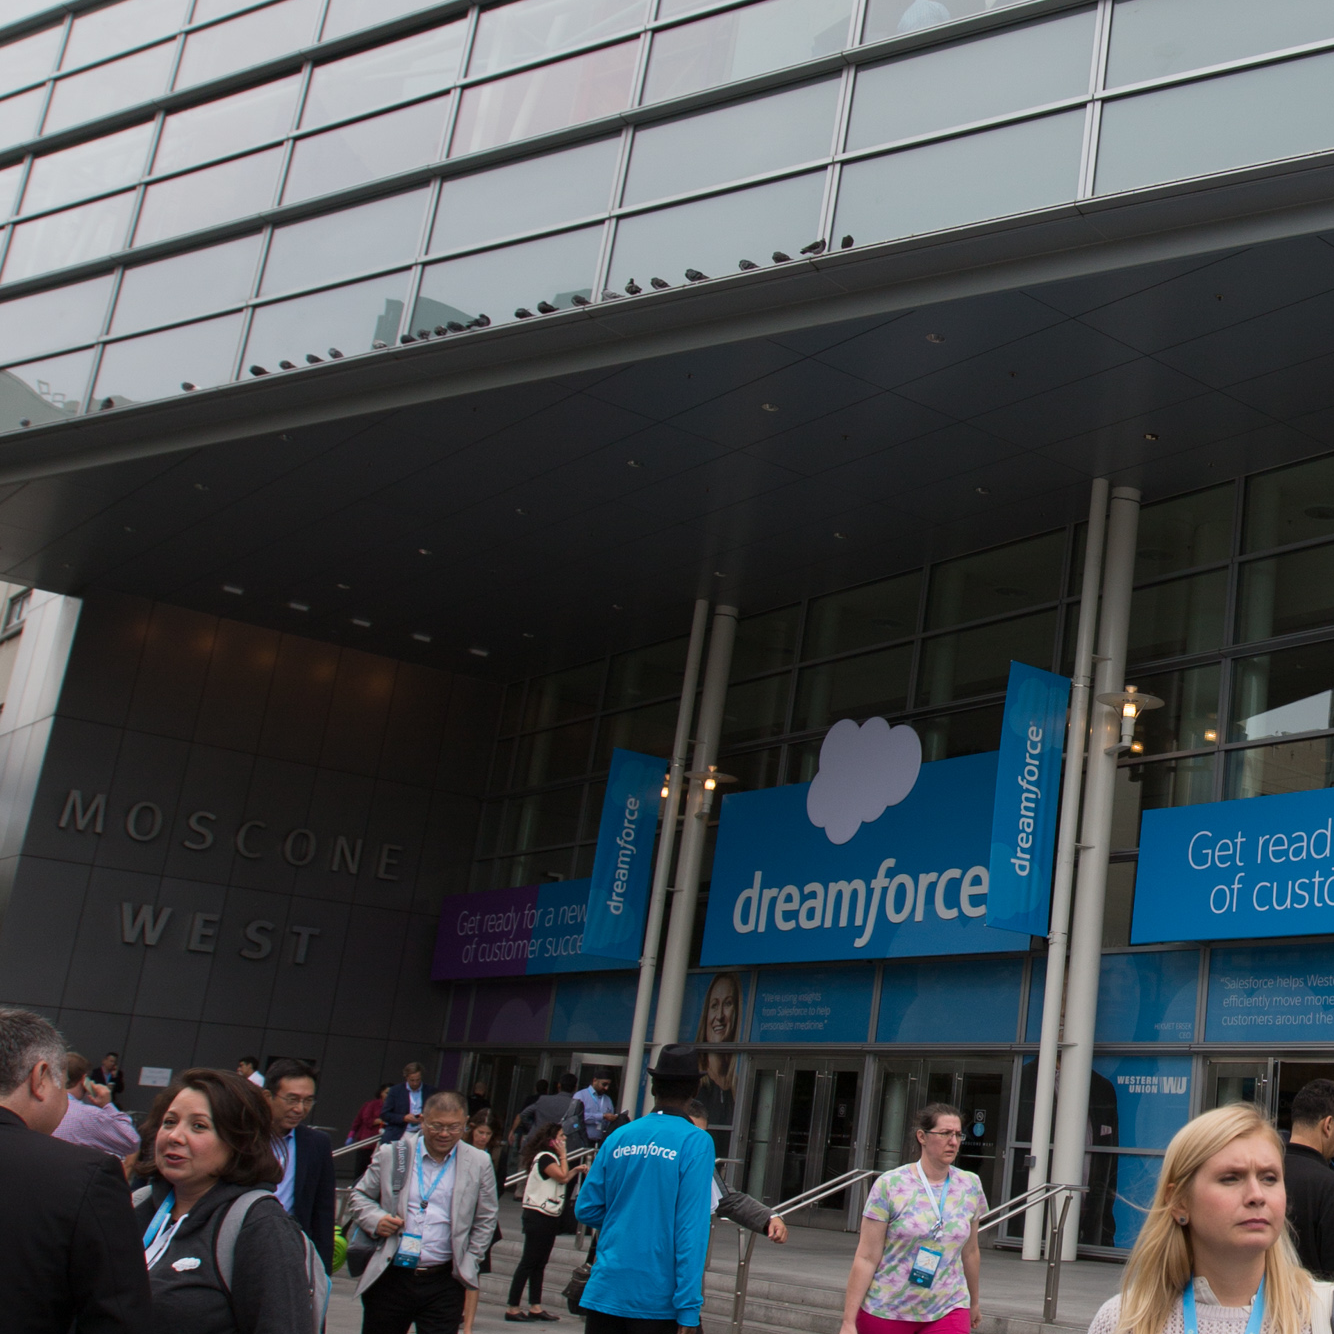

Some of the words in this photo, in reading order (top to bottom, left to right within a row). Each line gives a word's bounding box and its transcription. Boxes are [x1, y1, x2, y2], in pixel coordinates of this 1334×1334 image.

[1010, 725, 1042, 877] dreamforce
[57, 789, 403, 882] MOSCONE
[1188, 830, 1247, 870] Get
[606, 797, 639, 916] dreamforce
[733, 857, 990, 948] dreamforce
[1209, 873, 1245, 915] of
[120, 901, 321, 965] WEST
[457, 911, 481, 936] Get
[483, 906, 520, 939] ready
[523, 903, 541, 931] for
[544, 908, 554, 927] a
[461, 938, 478, 964] of
[478, 936, 543, 963] customer
[1276, 975, 1304, 991] helps
[1221, 1013, 1273, 1026] customers
[1275, 1011, 1313, 1025] around
[1315, 1011, 1334, 1024] the
[1223, 994, 1270, 1010] efficiently
[1272, 995, 1301, 1006] move
[1117, 1075, 1159, 1085] WESTERN
[1128, 1084, 1158, 1094] UNION
[612, 1141, 678, 1161] dreamforce
